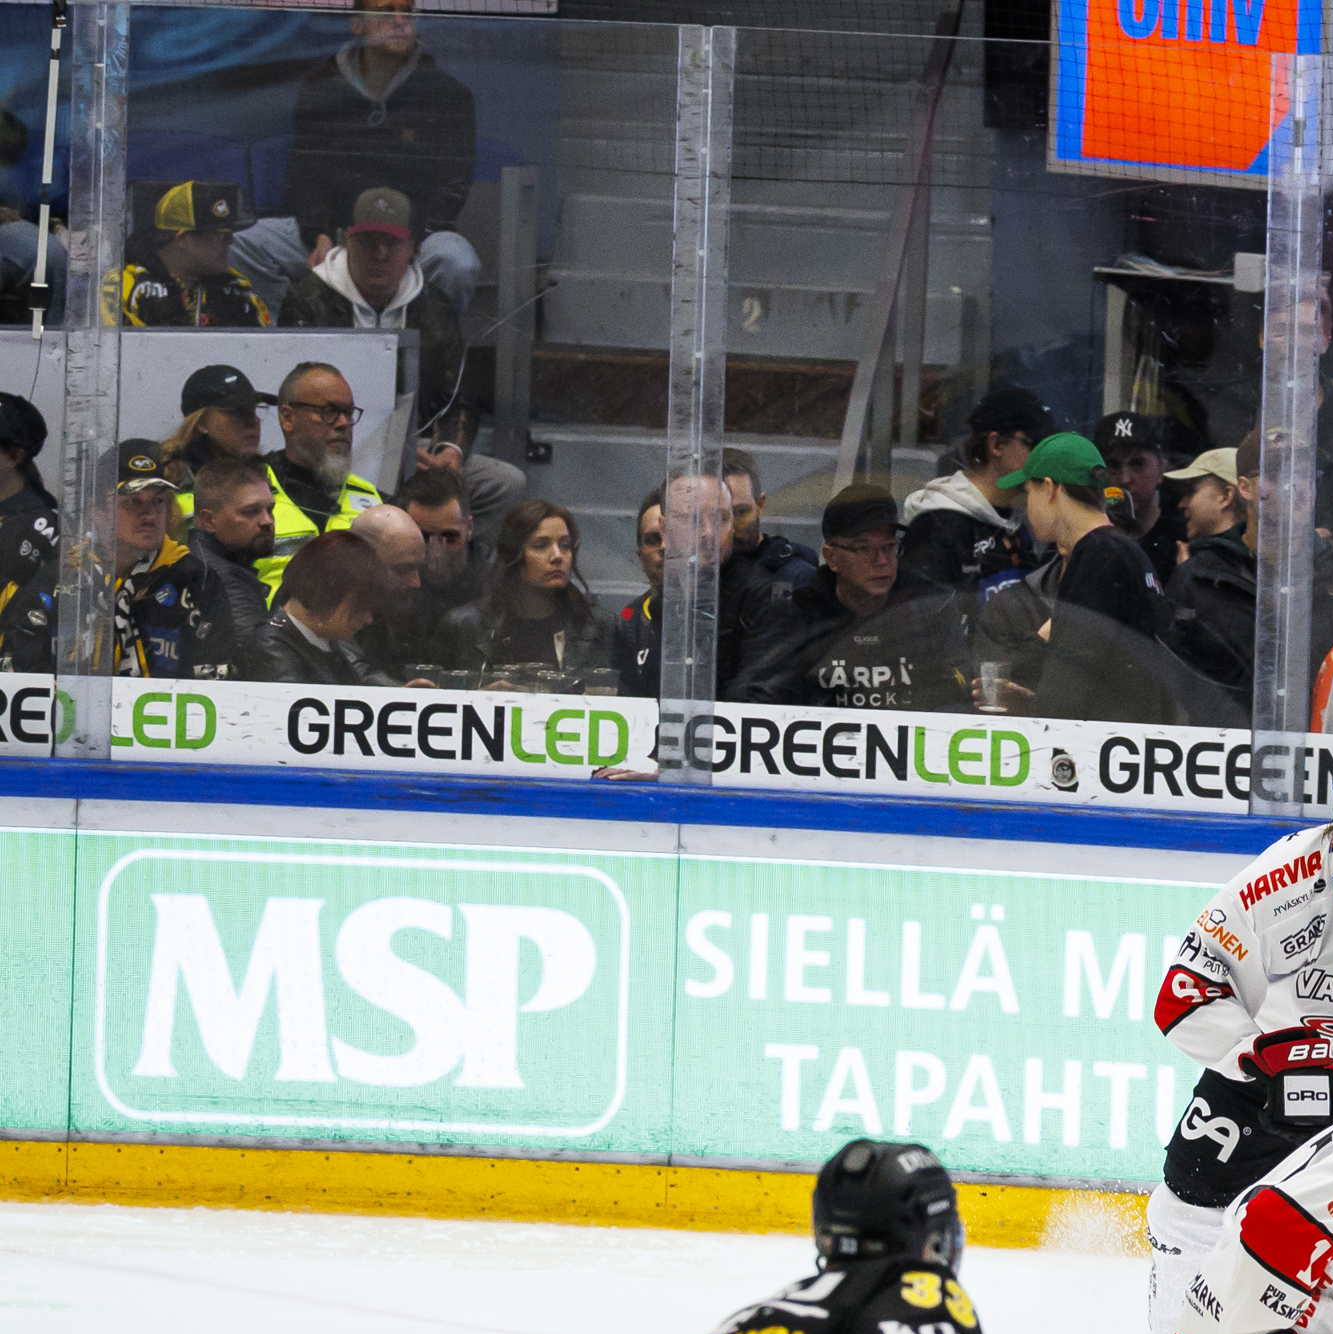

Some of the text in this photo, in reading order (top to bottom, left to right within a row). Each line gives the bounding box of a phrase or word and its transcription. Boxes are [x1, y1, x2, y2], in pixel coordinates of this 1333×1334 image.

[287, 697, 628, 767] GREENLED
[836, 691, 912, 707] HOCK
[1239, 850, 1322, 911] HARVIA
[130, 892, 598, 1092] MSP
[684, 904, 1021, 1016] SIELLÄ
